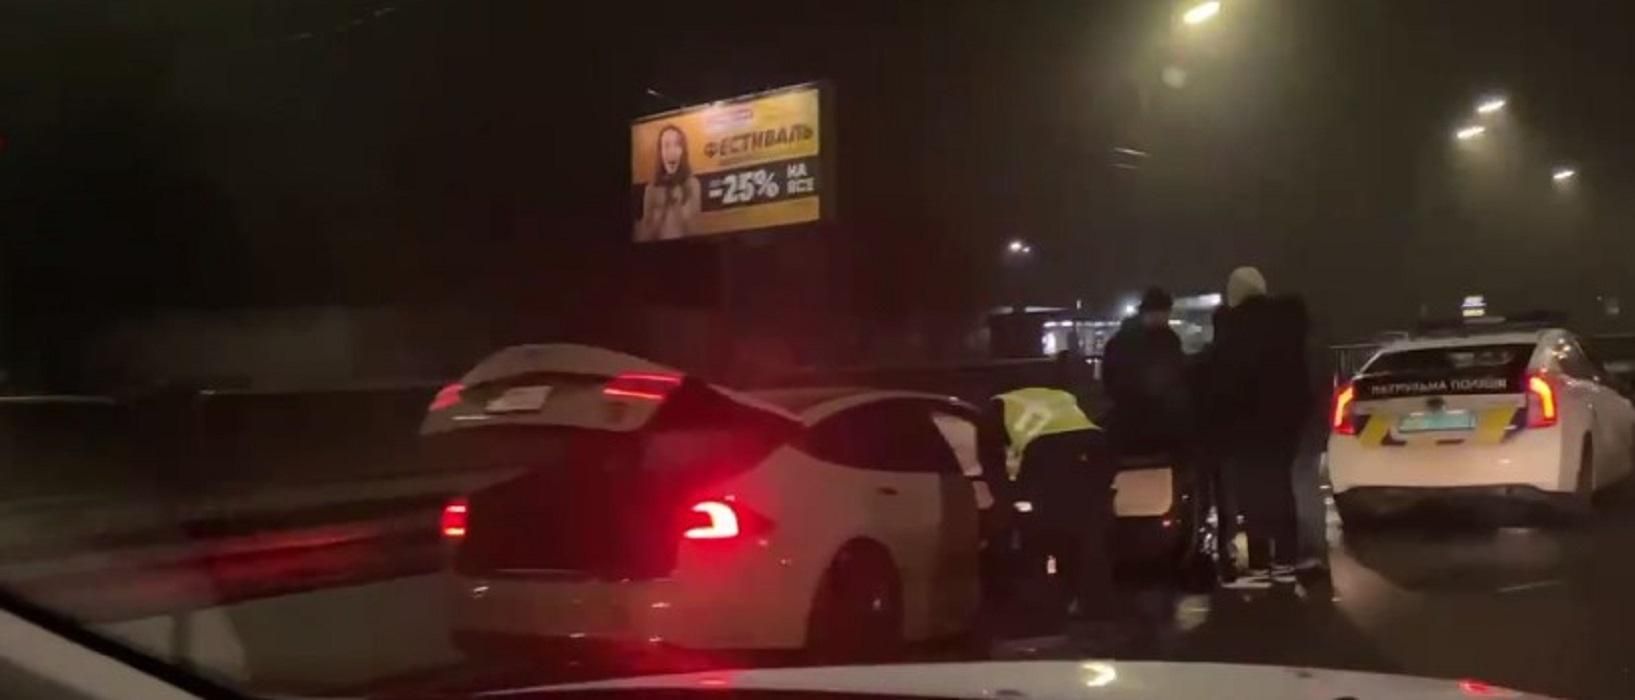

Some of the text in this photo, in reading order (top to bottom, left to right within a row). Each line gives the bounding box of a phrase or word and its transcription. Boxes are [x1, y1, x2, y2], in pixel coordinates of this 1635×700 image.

[704, 124, 814, 159] ФЕСТИВАЛЬ
[787, 163, 807, 177] НА
[709, 169, 779, 205] -25%
[1371, 380, 1447, 395] ПАТРУЛЬНА
